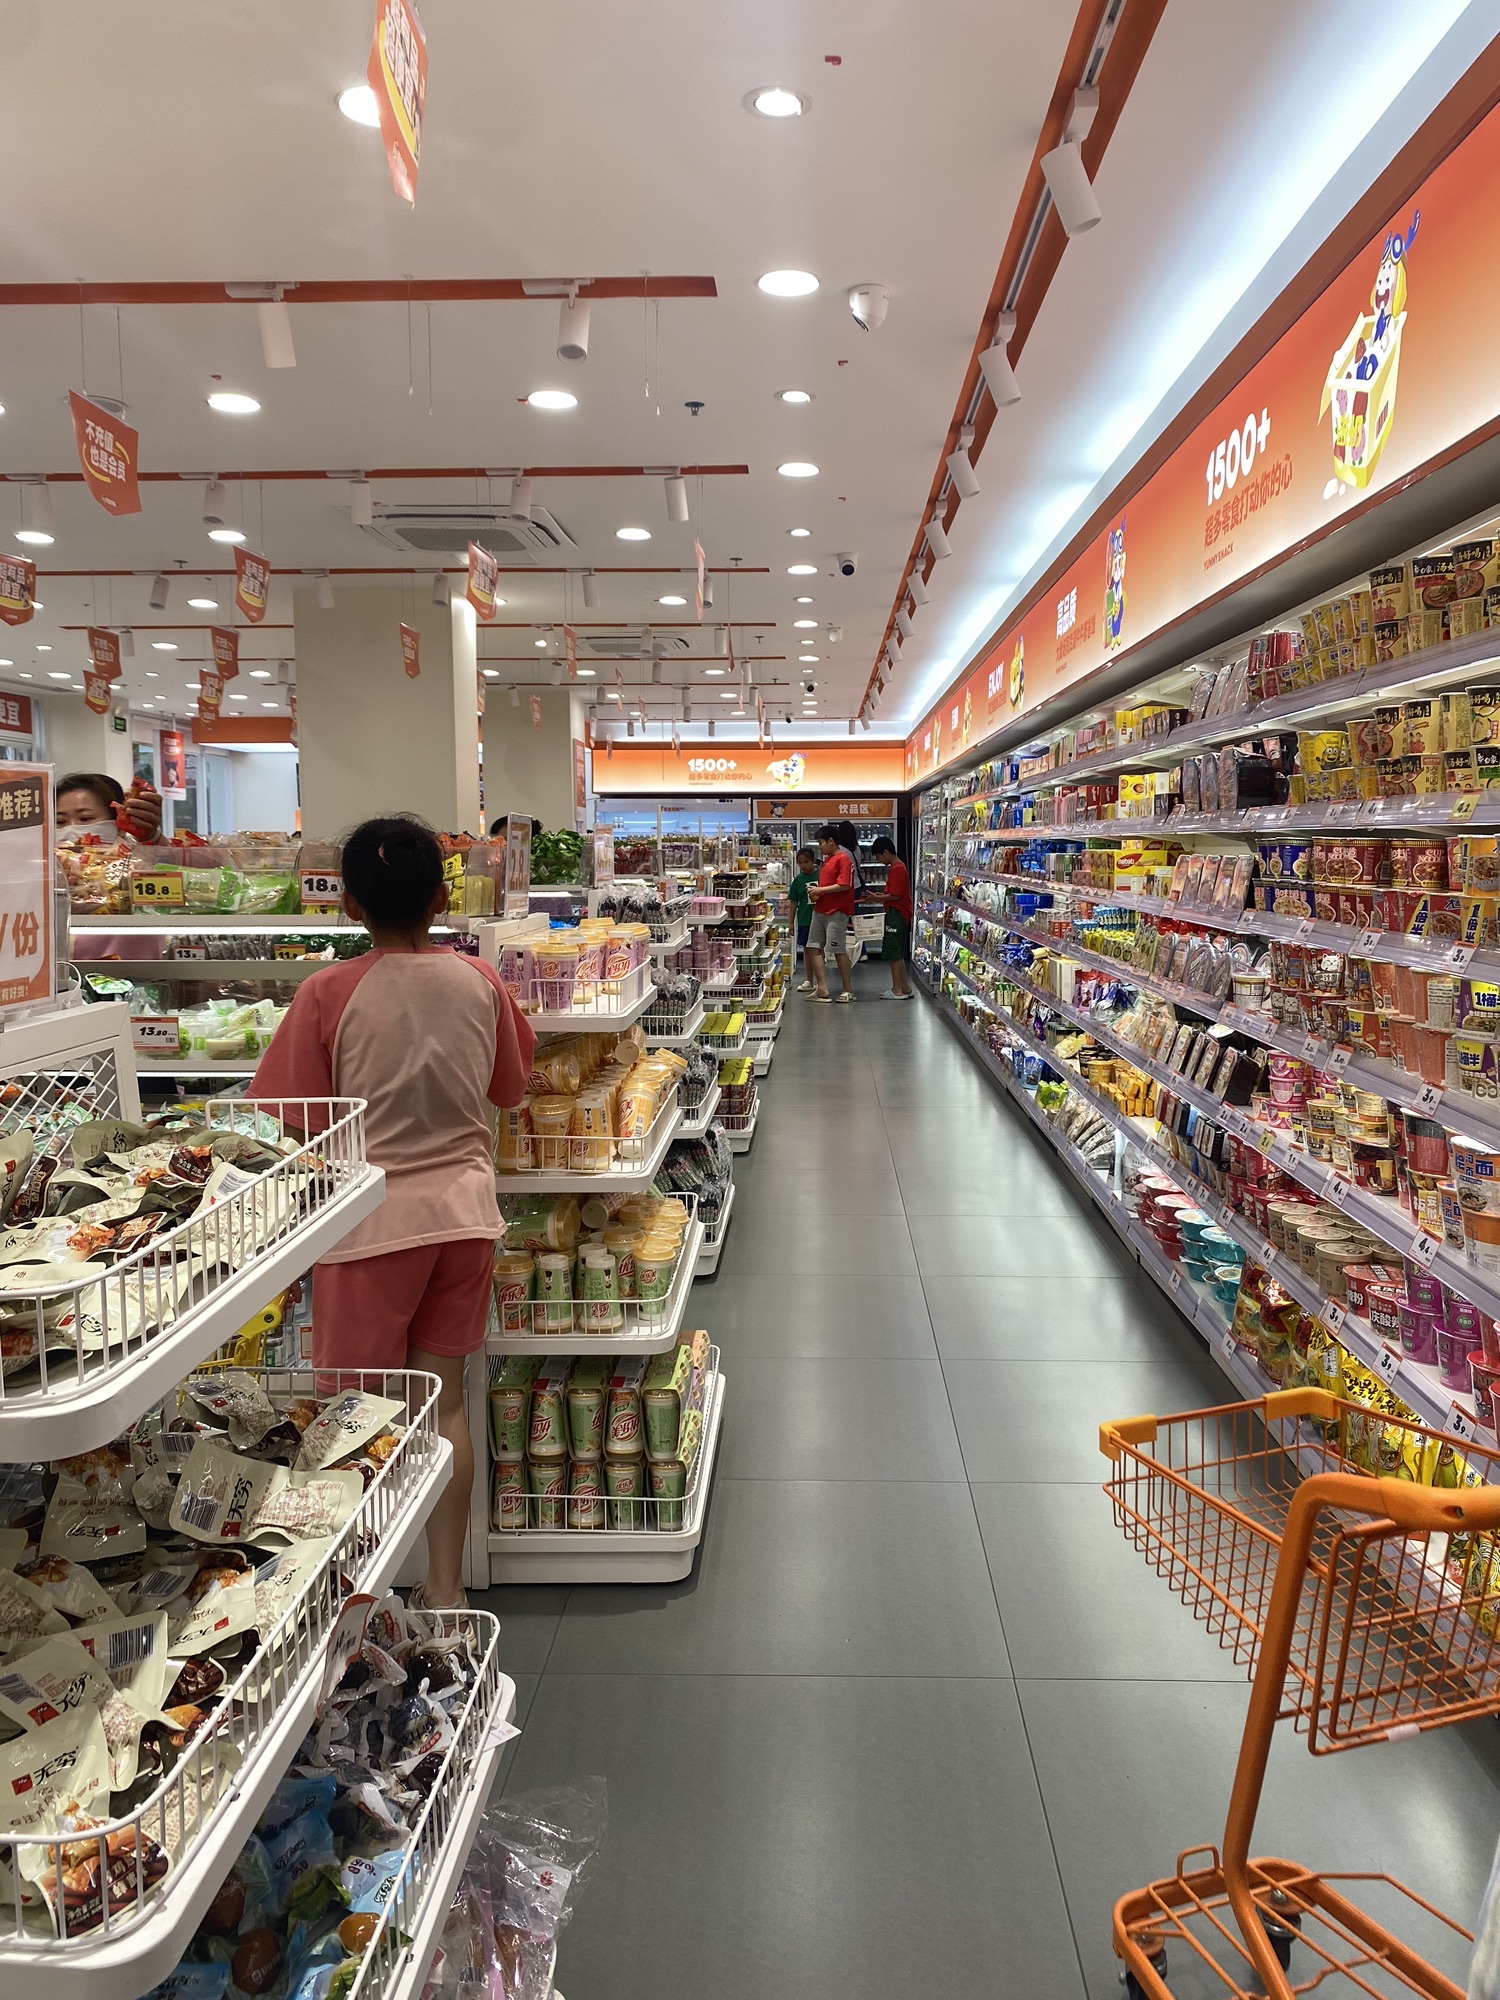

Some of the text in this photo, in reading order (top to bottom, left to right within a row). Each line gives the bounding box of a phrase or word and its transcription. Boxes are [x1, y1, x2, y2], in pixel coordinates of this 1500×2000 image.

[85, 418, 114, 454] 不充值
[90, 445, 126, 483] 也是会员
[1206, 406, 1271, 507] 1500+
[1204, 453, 1293, 548] 超多零食打动你的心
[1056, 586, 1077, 640] 高品质
[988, 661, 1004, 699] ENJOY
[688, 758, 737, 772] 1500+
[839, 803, 870, 815] 饮品区
[134, 883, 170, 896] 18.8
[304, 878, 338, 893] 18.8
[1418, 1237, 1430, 1255] 4.4
[1381, 1353, 1392, 1370] 3.9
[611, 1416, 639, 1440] 优乐美
[1453, 1413, 1466, 1435] 3.9
[227, 1477, 253, 1521] 无穷
[33, 1749, 77, 1786] 无穷
